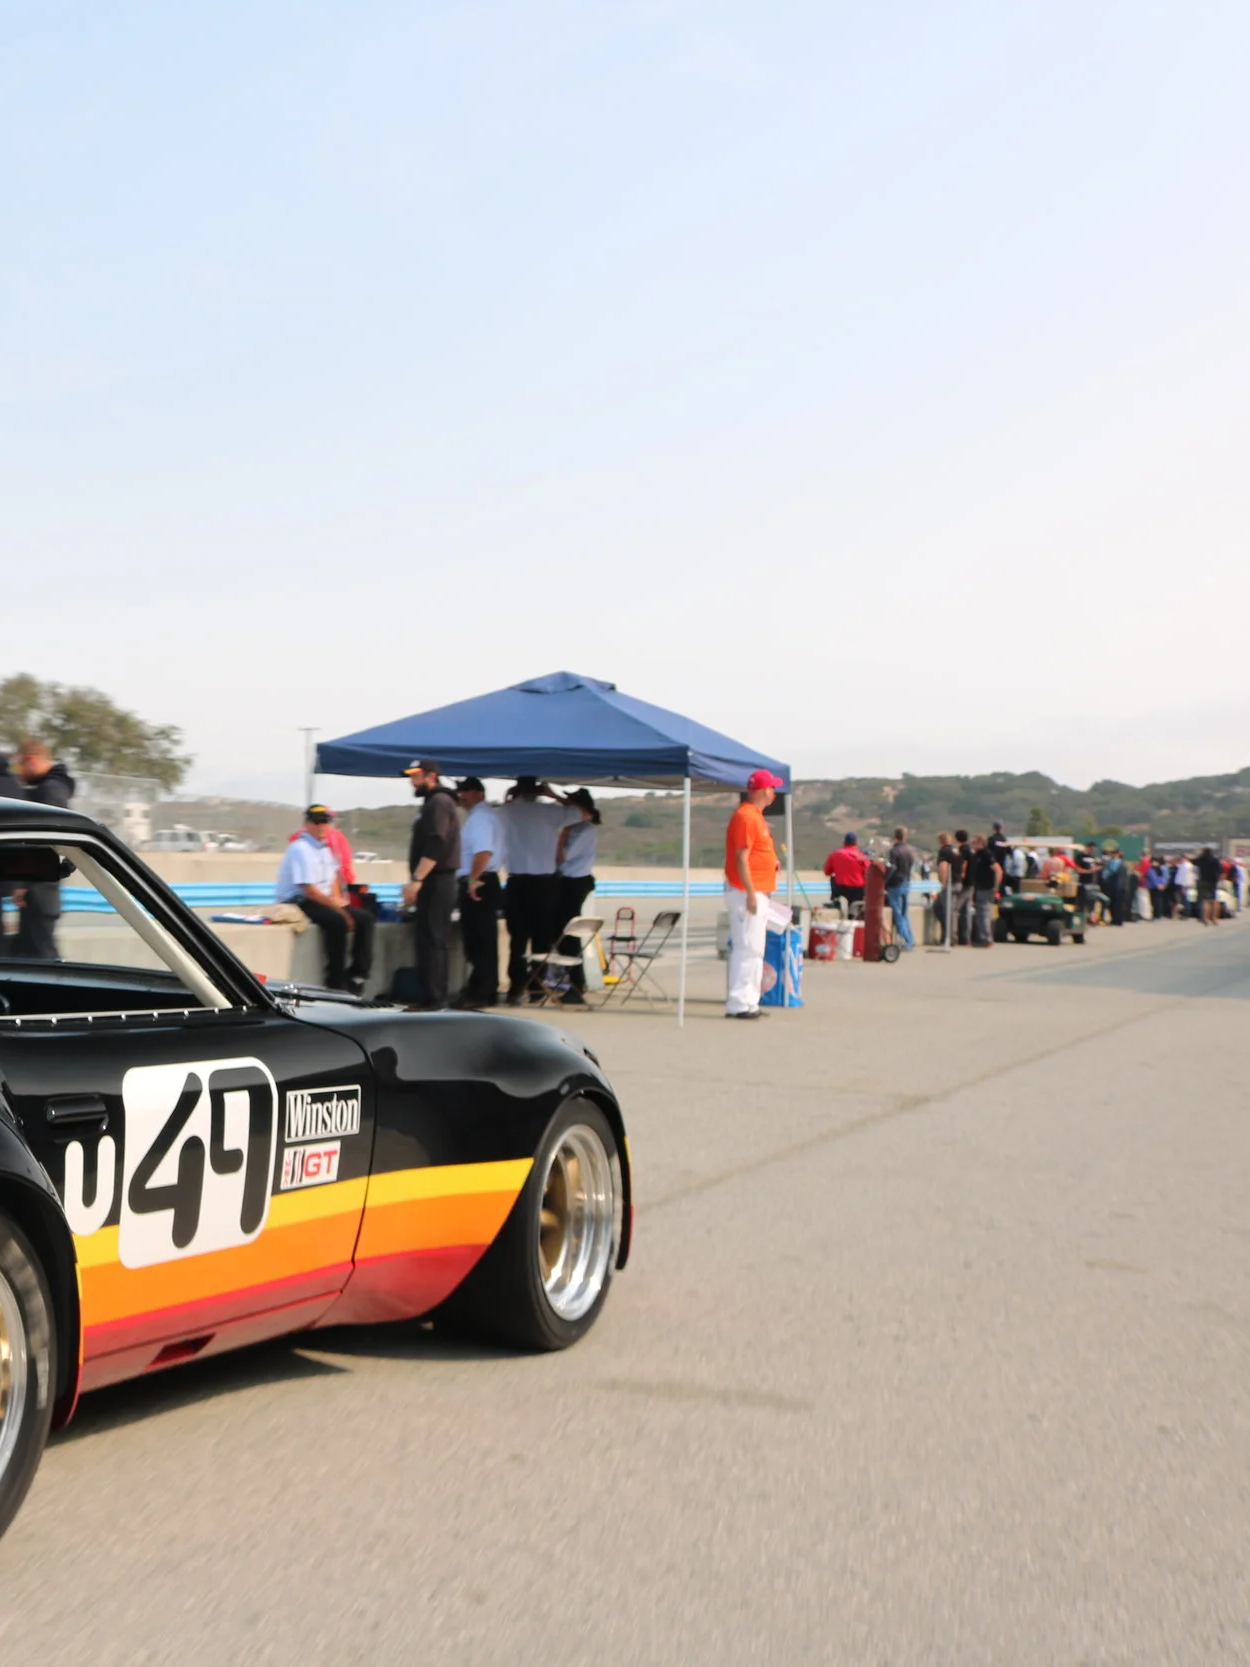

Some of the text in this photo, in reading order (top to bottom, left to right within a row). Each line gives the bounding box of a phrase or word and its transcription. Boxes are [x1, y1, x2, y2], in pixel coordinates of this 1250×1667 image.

[289, 1092, 358, 1139] Winston
[128, 1066, 274, 1249] 49
[304, 1149, 338, 1177] GT
